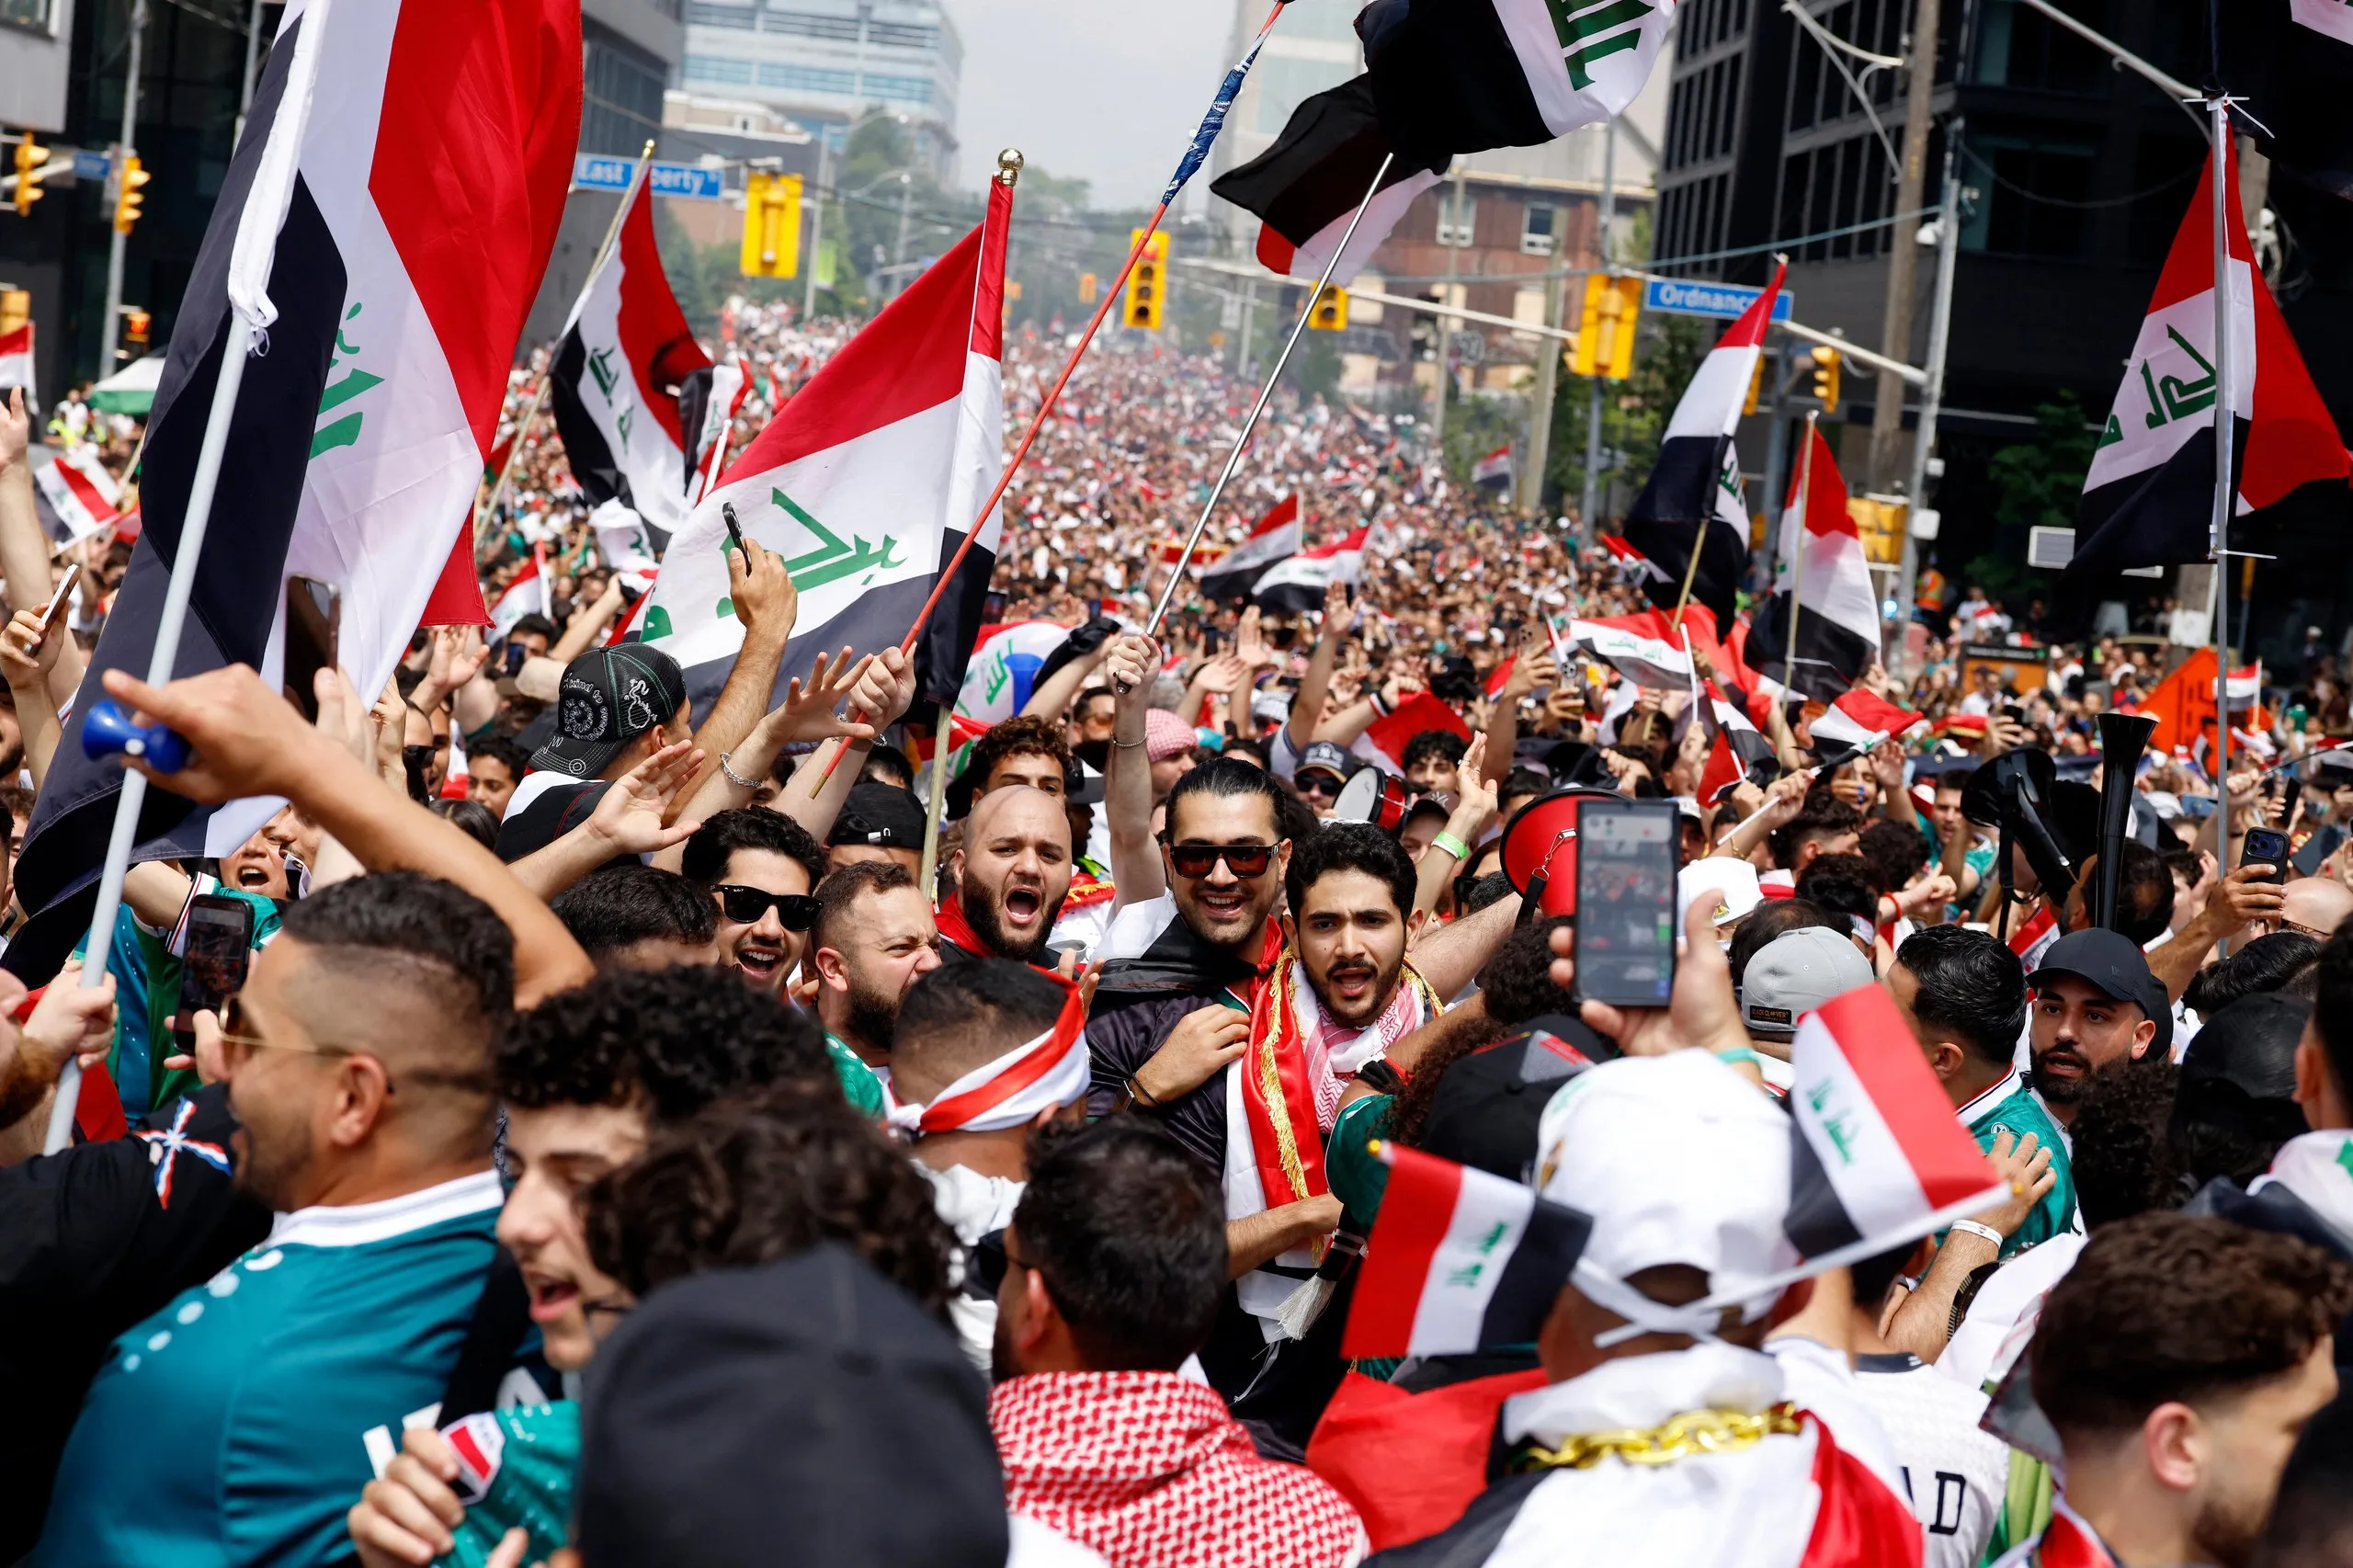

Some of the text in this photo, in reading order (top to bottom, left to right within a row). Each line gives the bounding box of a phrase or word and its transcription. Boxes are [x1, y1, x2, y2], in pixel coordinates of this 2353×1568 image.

[579, 157, 623, 184] East
[1659, 284, 1756, 313] Ordnanc
[569, 678, 594, 693] kind
[593, 689, 604, 704] to
